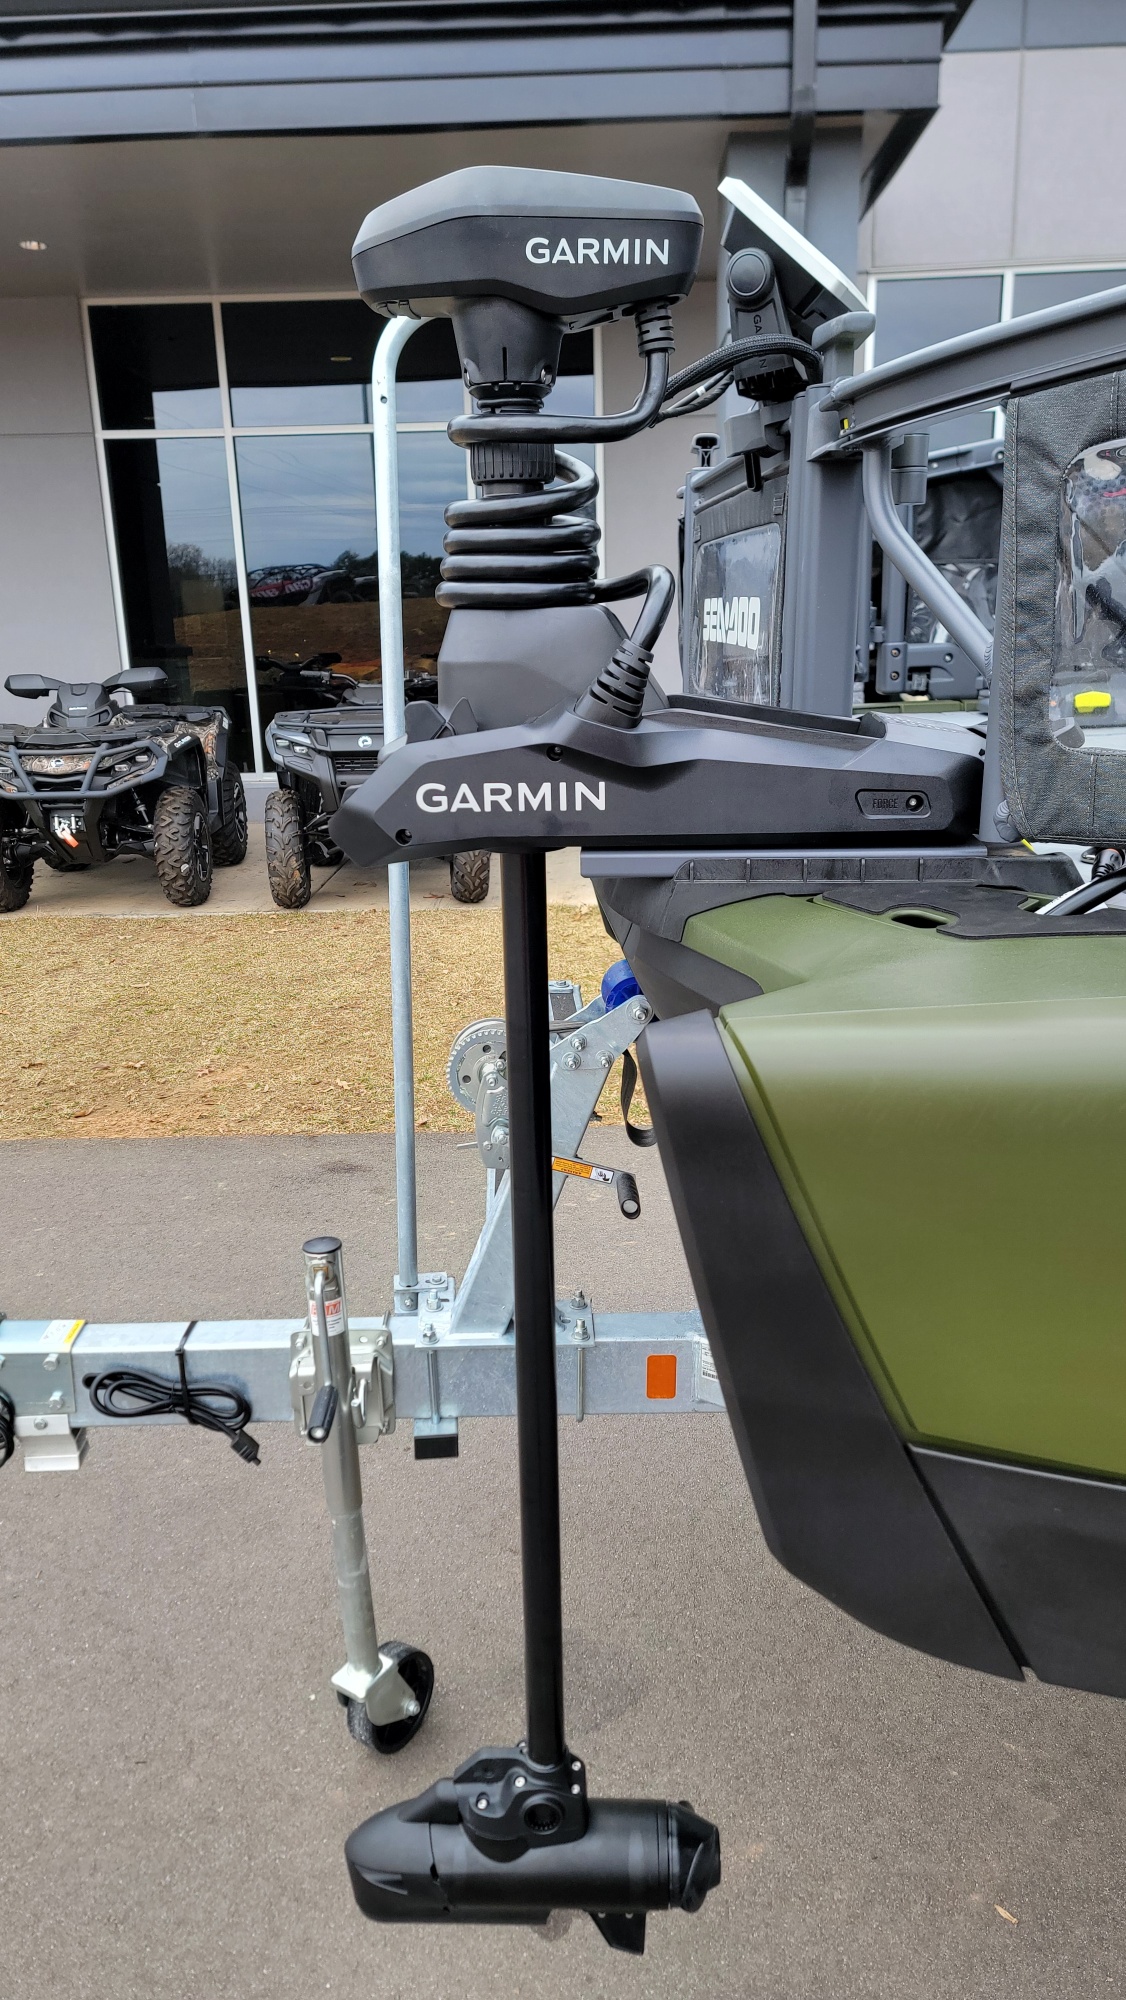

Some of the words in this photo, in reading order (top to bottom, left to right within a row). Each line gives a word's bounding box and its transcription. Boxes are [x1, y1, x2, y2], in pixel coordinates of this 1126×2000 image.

[525, 237, 669, 265] GARMIN
[753, 314, 768, 369] GAN
[415, 781, 606, 813] GARMIN
[872, 798, 899, 809] FORCE
